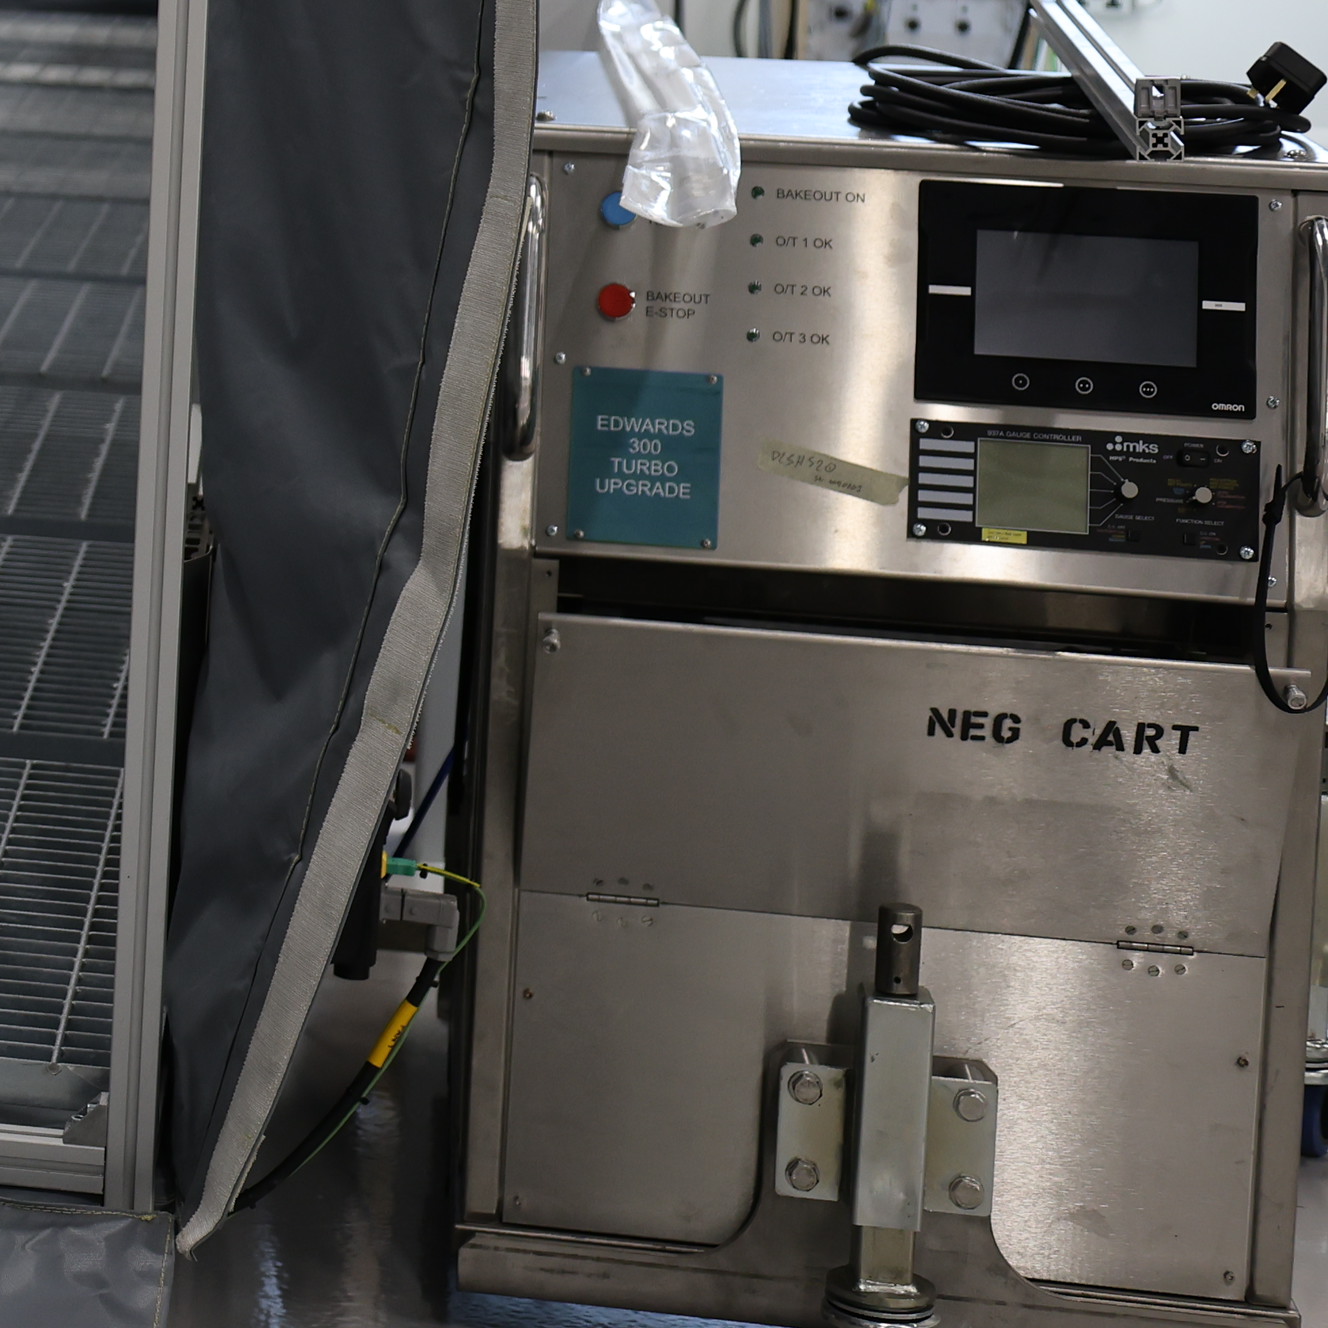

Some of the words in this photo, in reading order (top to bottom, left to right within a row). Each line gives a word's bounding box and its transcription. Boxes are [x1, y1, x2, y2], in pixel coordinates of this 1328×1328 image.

[776, 188, 841, 203] BAKEOUT
[845, 191, 866, 203] ON
[775, 235, 798, 248] O/T
[802, 236, 809, 248] 1
[813, 237, 833, 249] OK
[646, 290, 711, 305] BAKEOUT
[773, 283, 797, 296] O/T
[800, 284, 808, 297] 2
[812, 285, 832, 298] OK
[645, 306, 696, 320] E-STOP
[772, 330, 795, 343] O/T
[798, 332, 806, 344] 3
[810, 333, 830, 346] OK
[596, 414, 696, 437] EDWARDS
[1033, 432, 1082, 442] CONTROLLER
[628, 437, 662, 455] 300
[1122, 439, 1160, 454] mks
[610, 457, 679, 477] TURBO
[595, 477, 691, 499] UPGRADE
[926, 706, 1022, 744] NEG
[1061, 717, 1200, 755] CART
